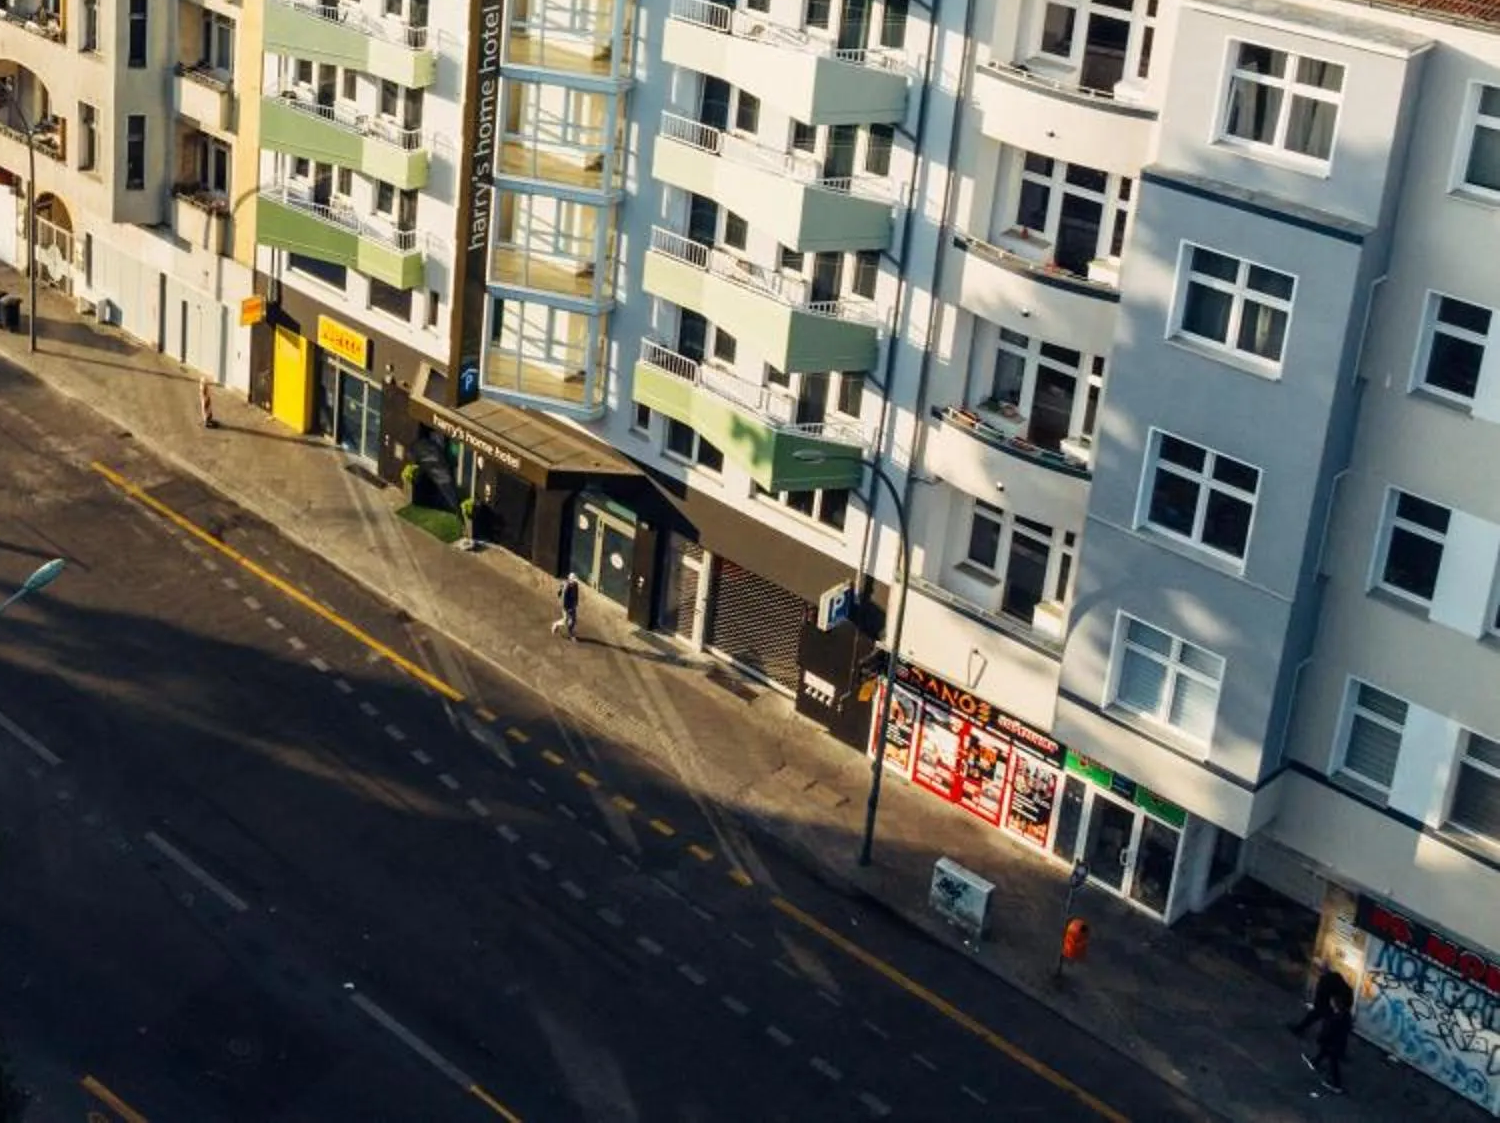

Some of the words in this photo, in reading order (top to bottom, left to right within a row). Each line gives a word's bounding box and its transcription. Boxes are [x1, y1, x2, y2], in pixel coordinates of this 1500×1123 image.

[478, 5, 500, 74] hotel
[473, 79, 495, 158] home
[467, 161, 491, 251] harry's
